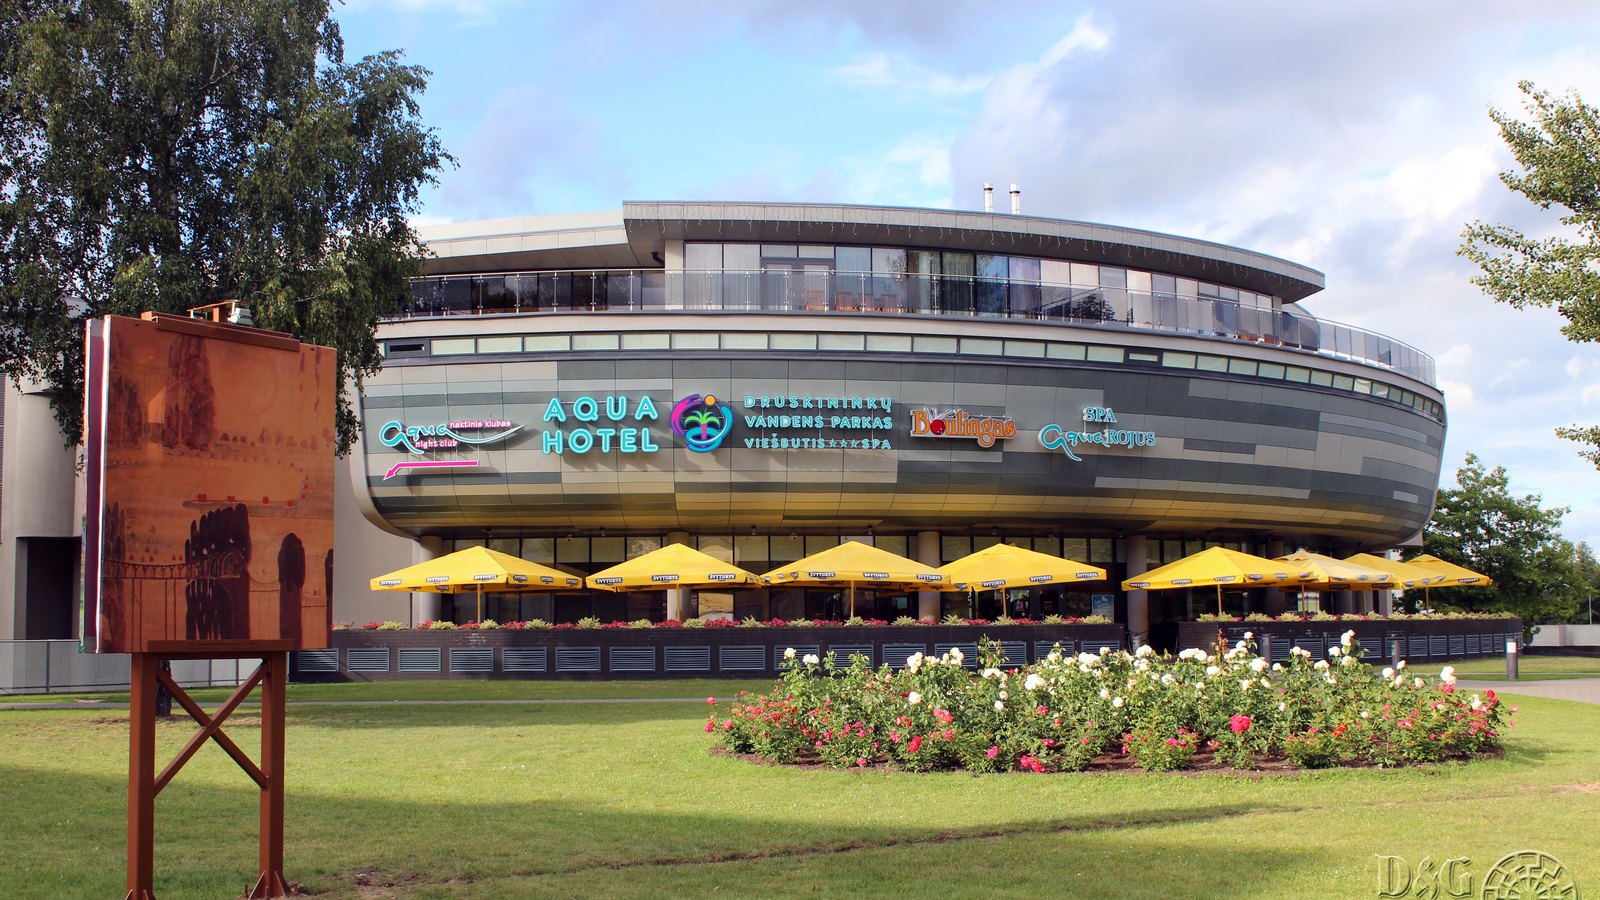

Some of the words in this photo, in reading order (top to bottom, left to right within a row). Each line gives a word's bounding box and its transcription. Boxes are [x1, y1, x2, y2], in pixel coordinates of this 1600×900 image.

[543, 395, 659, 422] AQUA
[744, 395, 892, 413] DRUSKININKŲ
[744, 415, 824, 428] VANDENS
[830, 415, 893, 430] PARKAS
[1083, 407, 1117, 423] SPA
[449, 420, 483, 429] naktinis
[484, 419, 511, 428] klubas
[415, 440, 438, 448] night
[439, 439, 458, 448] club
[542, 427, 660, 455] HOTEL
[744, 433, 825, 449] VIEŠBUTIS
[861, 438, 891, 450] SPA
